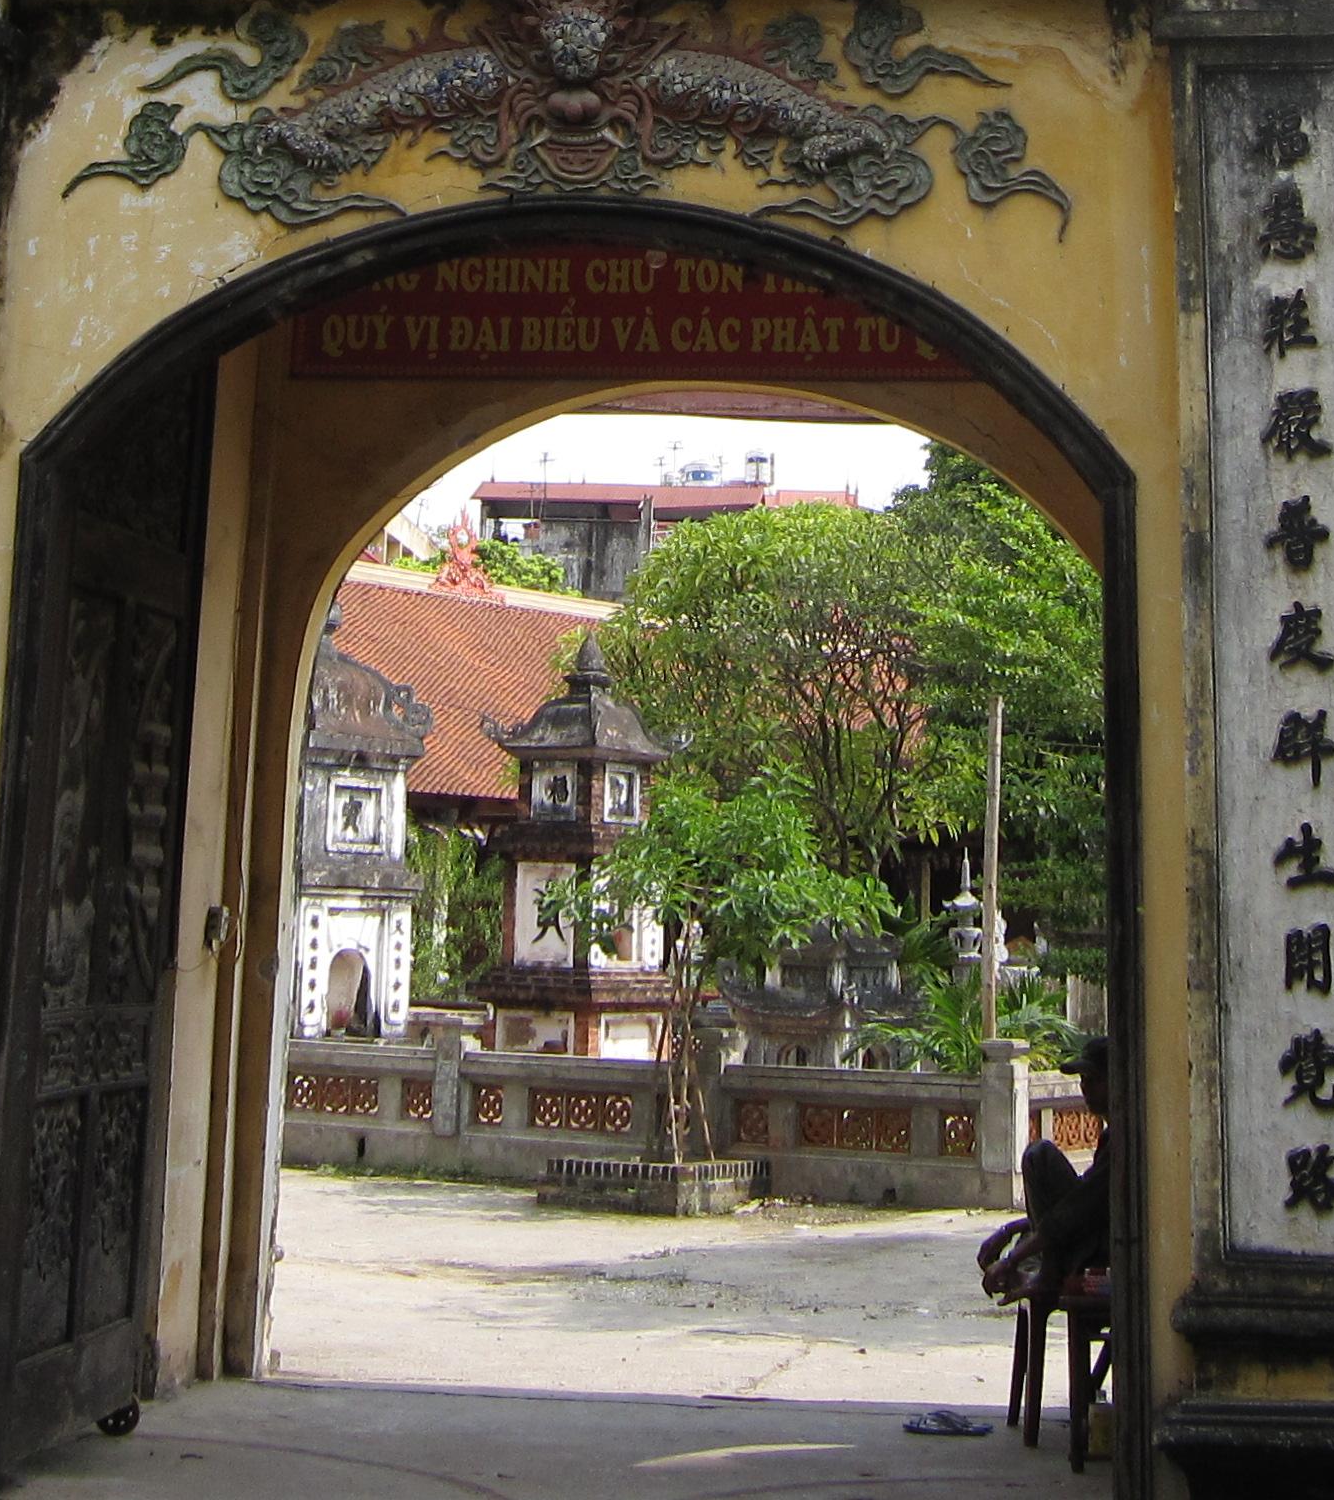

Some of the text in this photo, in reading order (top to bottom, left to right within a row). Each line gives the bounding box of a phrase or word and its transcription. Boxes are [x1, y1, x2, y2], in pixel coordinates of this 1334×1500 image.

[435, 257, 572, 294] NGHINH
[321, 304, 396, 358] QUÝ
[403, 315, 441, 360] VỊ
[447, 315, 512, 360] ĐẠI
[520, 296, 603, 353] BIỂU
[611, 305, 661, 353] VÀ
[670, 305, 743, 353] CÁC
[750, 306, 846, 362] PHẬT
